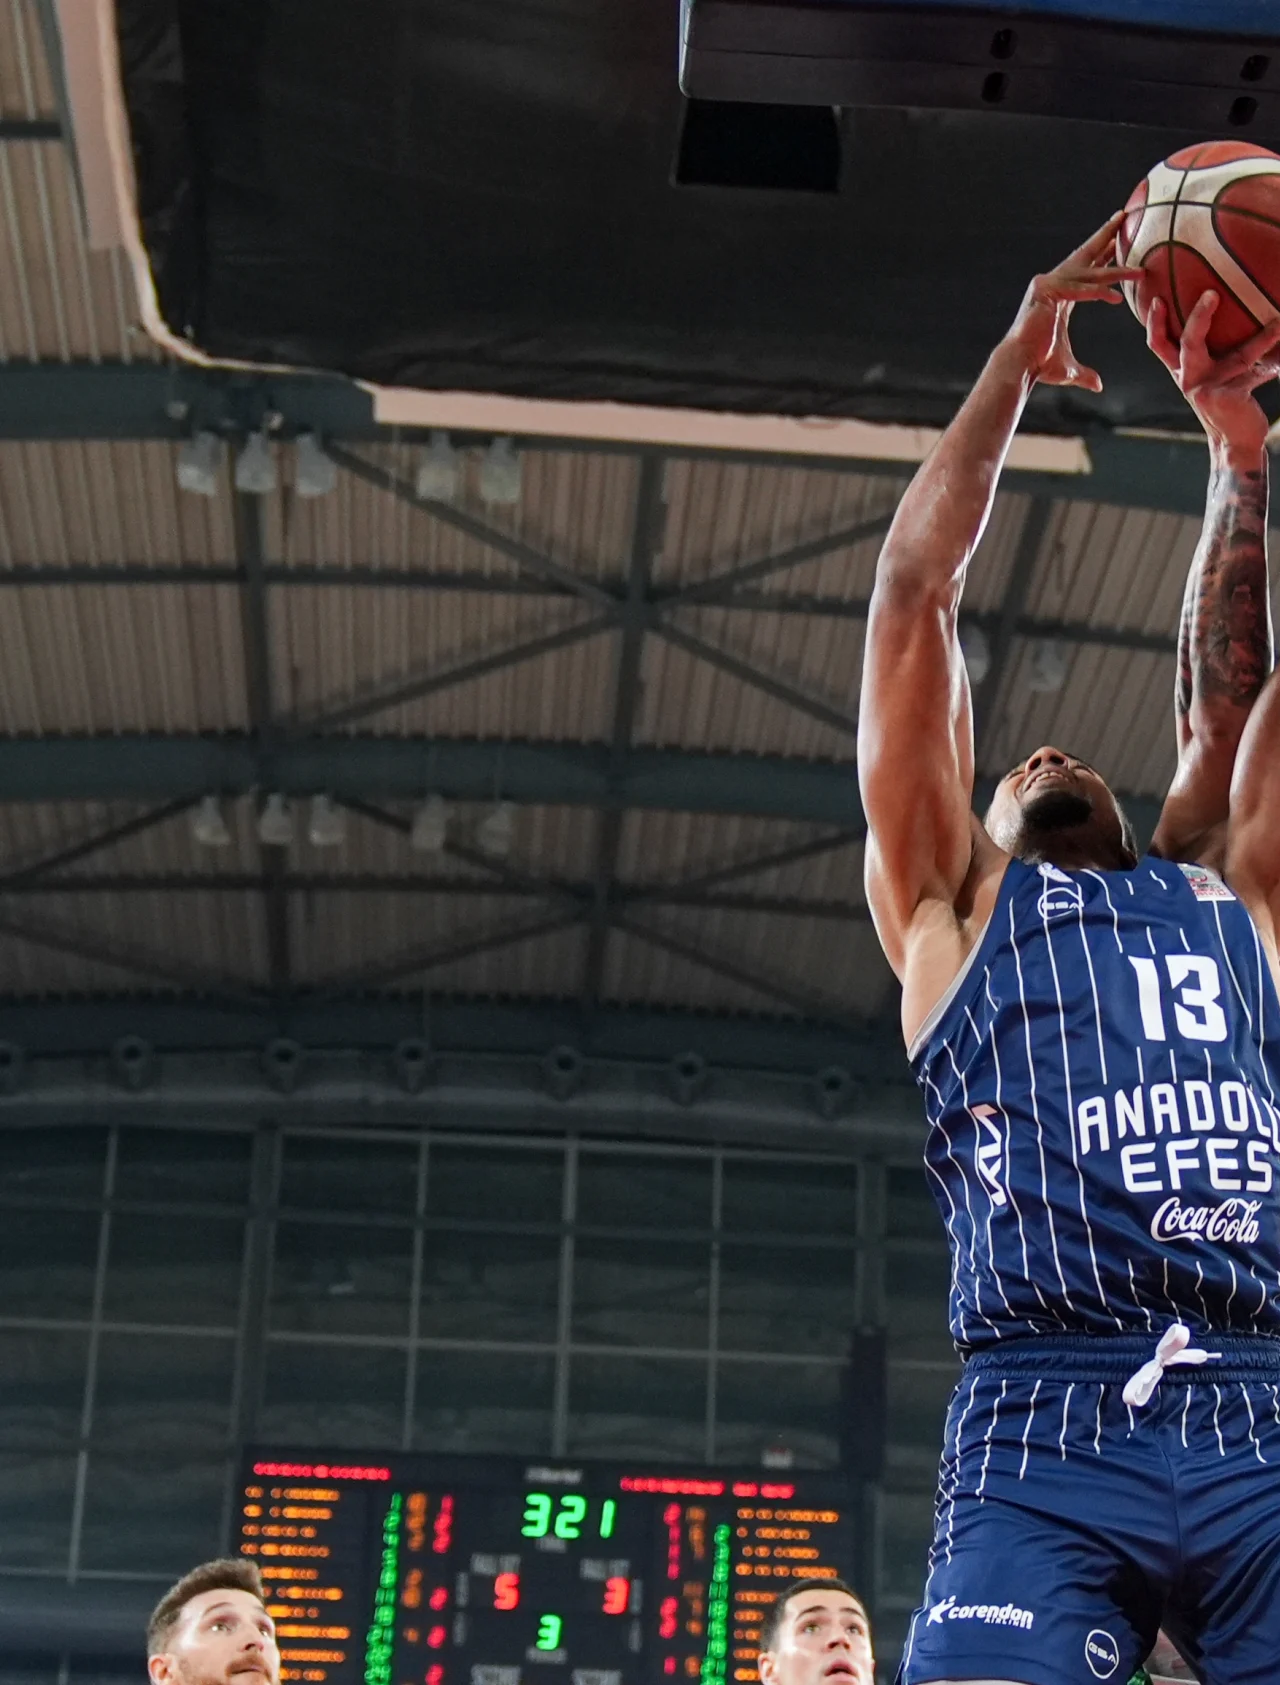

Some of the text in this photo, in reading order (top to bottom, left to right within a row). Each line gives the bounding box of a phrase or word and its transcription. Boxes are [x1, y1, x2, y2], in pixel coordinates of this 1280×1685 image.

[1128, 954, 1228, 1042] 13
[1120, 1138, 1272, 1193] EFES
[1151, 1196, 1262, 1243] Coca-Cola
[493, 1572, 520, 1610] 5
[602, 1576, 629, 1615] 3
[536, 1614, 562, 1651] 3
[948, 1602, 1034, 1630] corendon
